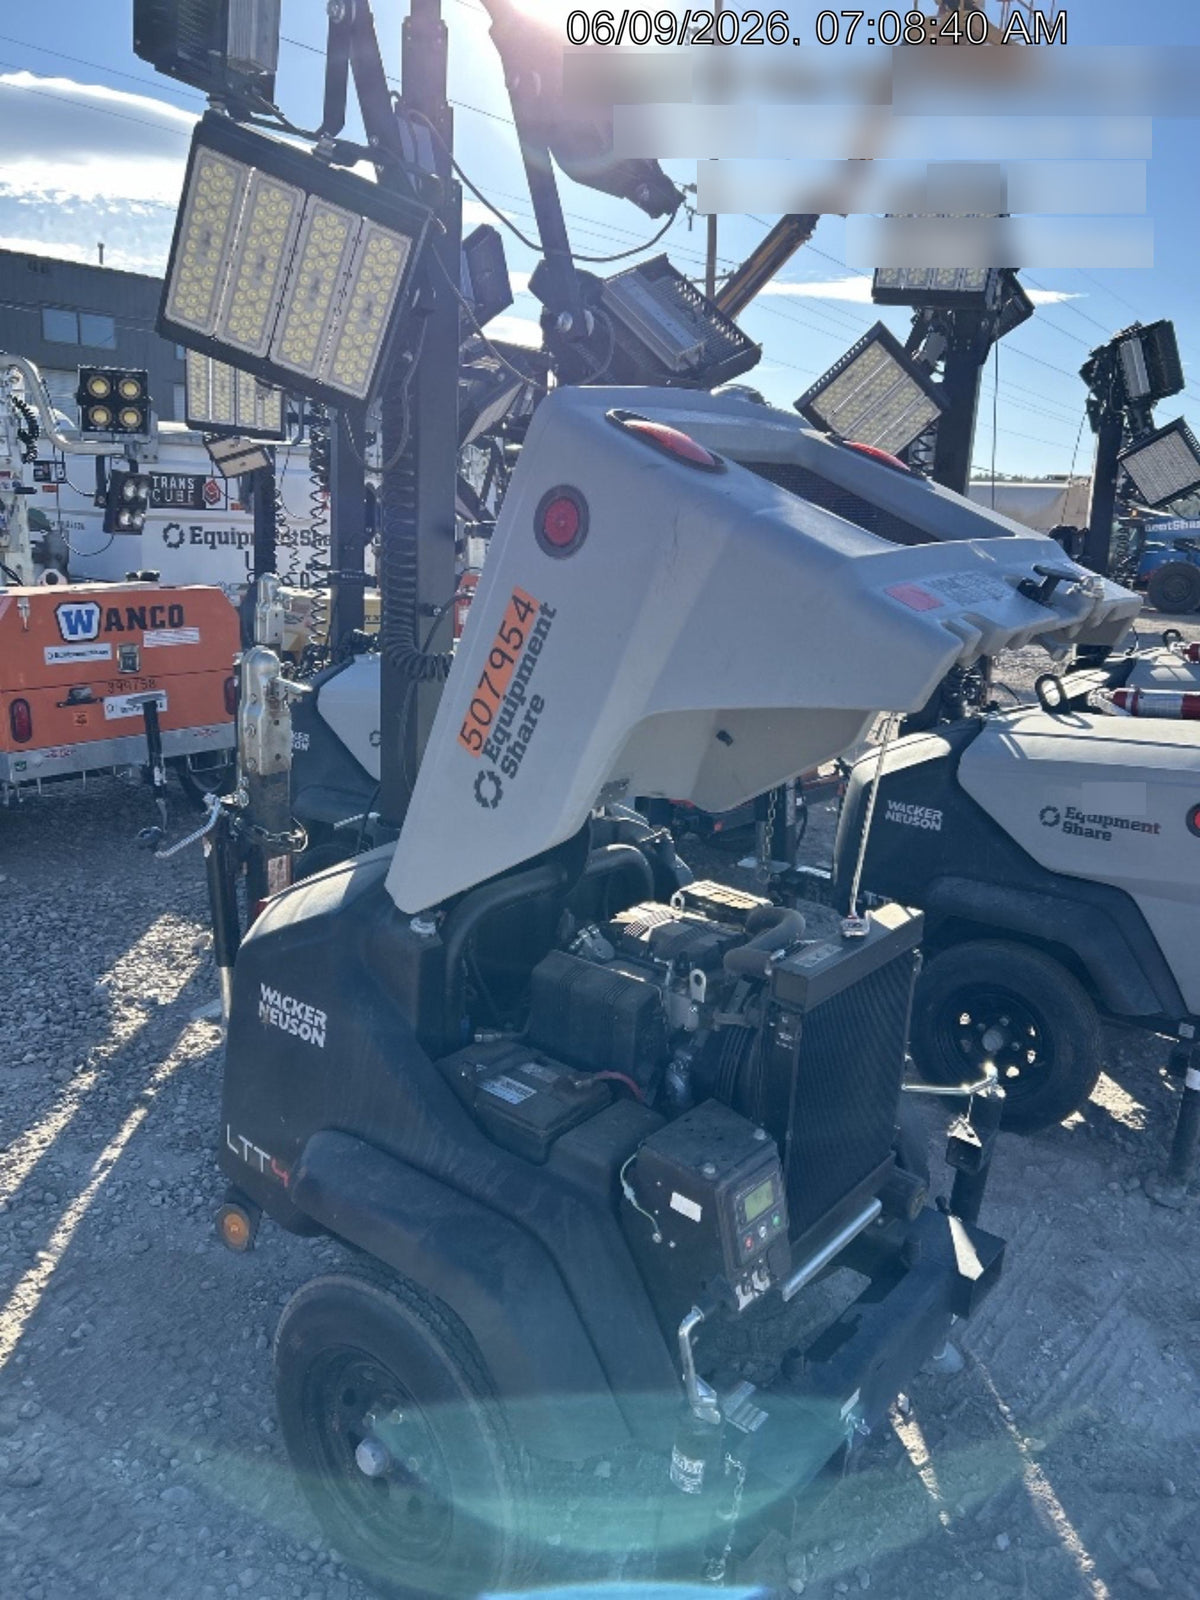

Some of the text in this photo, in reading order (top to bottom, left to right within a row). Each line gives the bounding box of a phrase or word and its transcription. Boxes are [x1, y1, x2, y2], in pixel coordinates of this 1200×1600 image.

[152, 475, 195, 491] TRANS
[61, 603, 185, 636] WANCO
[460, 594, 535, 751] 507954
[481, 601, 558, 765] Equipment
[500, 692, 546, 780] Share
[885, 810, 943, 832] NEUSON
[887, 799, 943, 823] WACKER
[1062, 820, 1113, 842] Share
[258, 1000, 327, 1049] NEUSON
[260, 982, 328, 1030] WACKER
